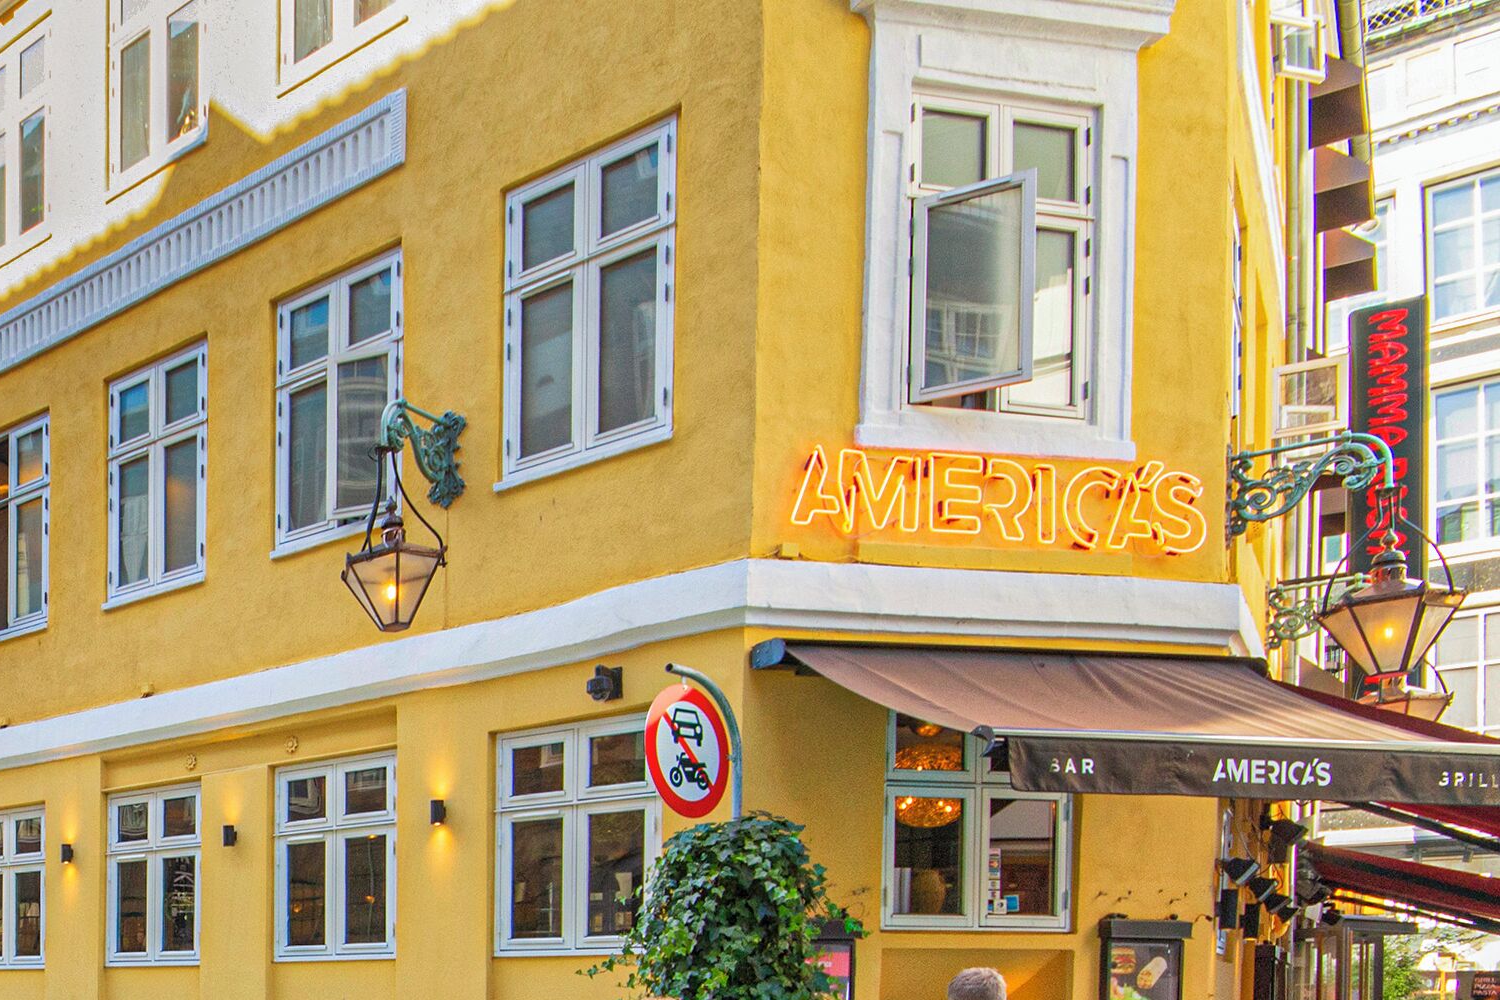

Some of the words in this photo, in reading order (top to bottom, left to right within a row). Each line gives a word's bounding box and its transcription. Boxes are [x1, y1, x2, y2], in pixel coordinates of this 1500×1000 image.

[1368, 308, 1409, 452] MAMMA
[790, 444, 1208, 553] AMERICA'S
[1049, 757, 1095, 774] BAR
[1212, 757, 1332, 787] AMERICA'S
